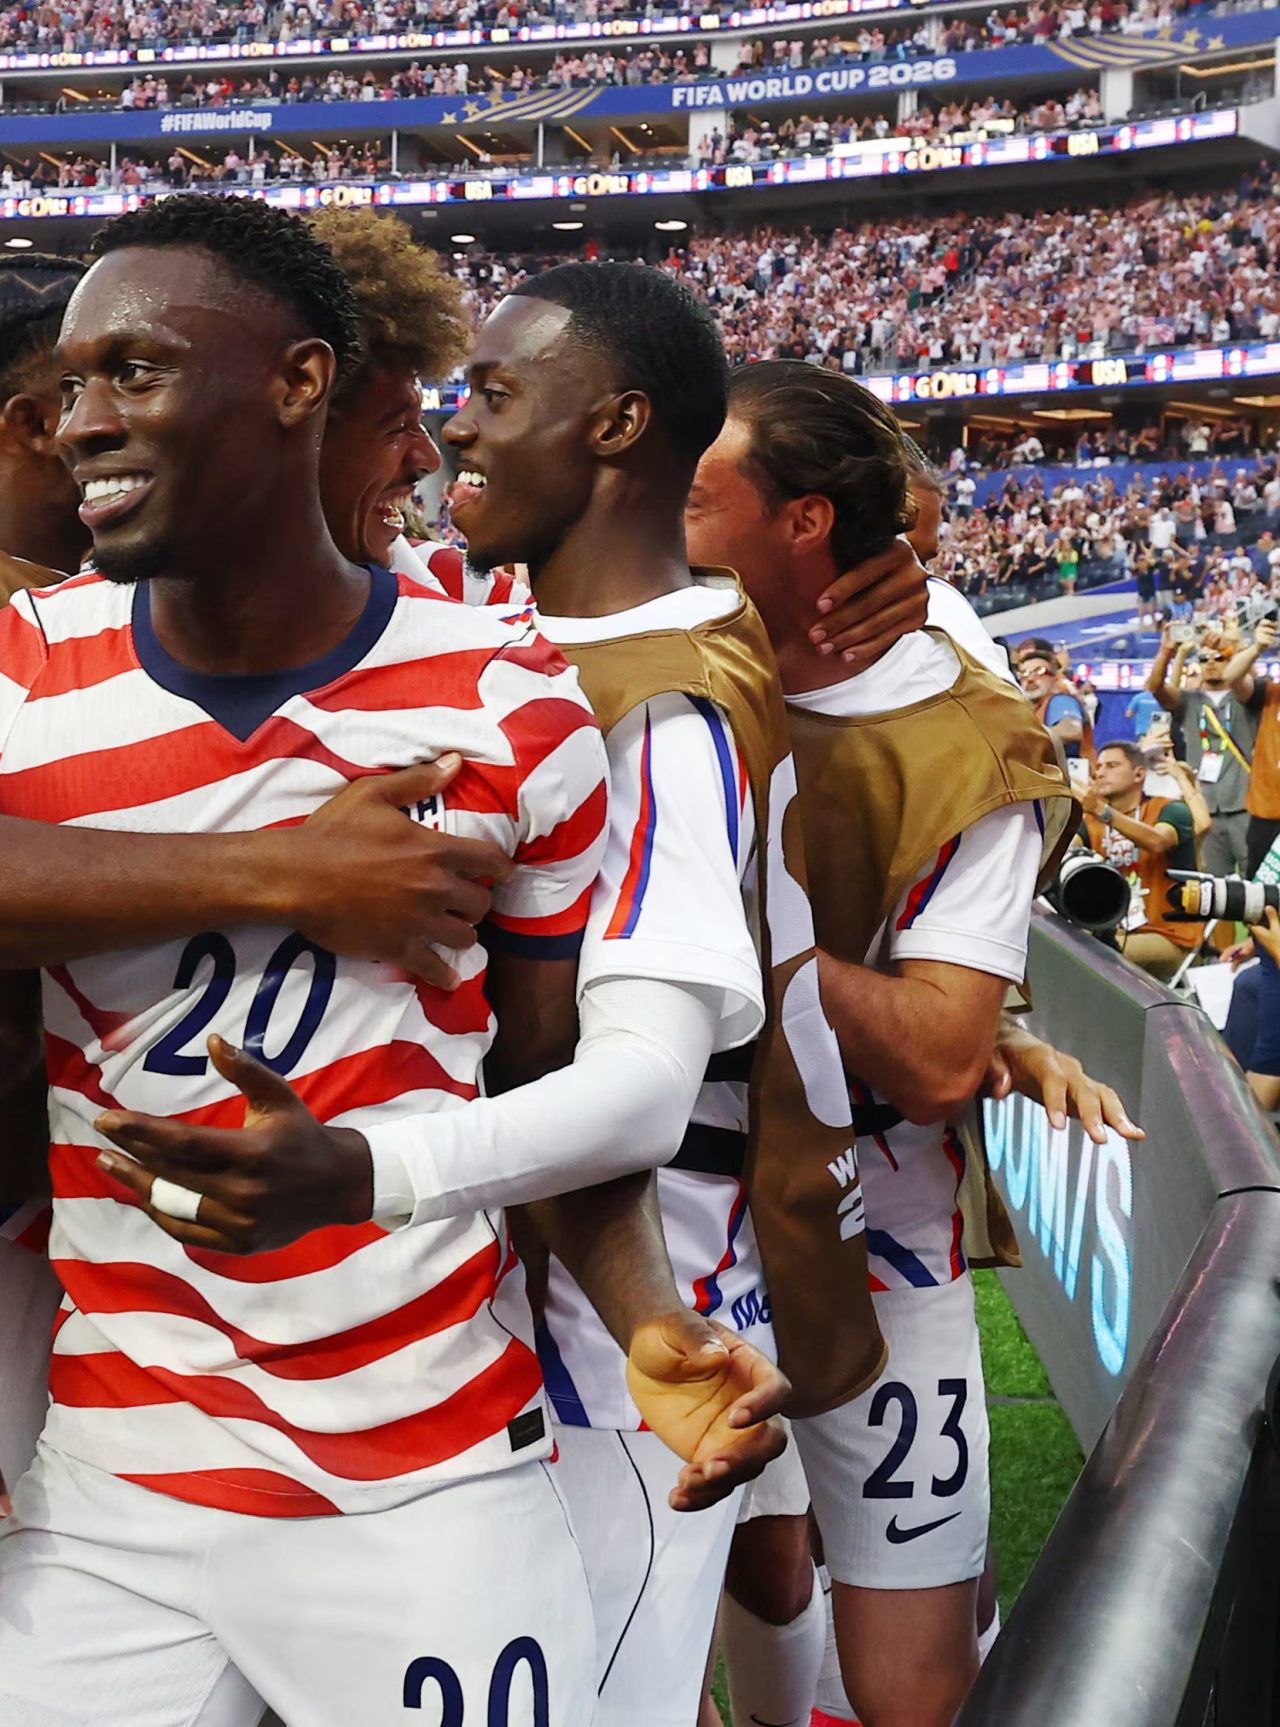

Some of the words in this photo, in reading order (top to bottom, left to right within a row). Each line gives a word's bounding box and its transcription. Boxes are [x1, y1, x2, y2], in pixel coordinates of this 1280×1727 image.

[672, 84, 724, 107] FIFA
[726, 75, 813, 102] WORLD
[815, 69, 865, 92] CUP
[868, 58, 957, 87] 2026
[160, 110, 273, 132] #FIFAWorldCup
[1092, 358, 1128, 385] USA
[143, 931, 337, 1077] 20
[862, 1378, 969, 1500] 23
